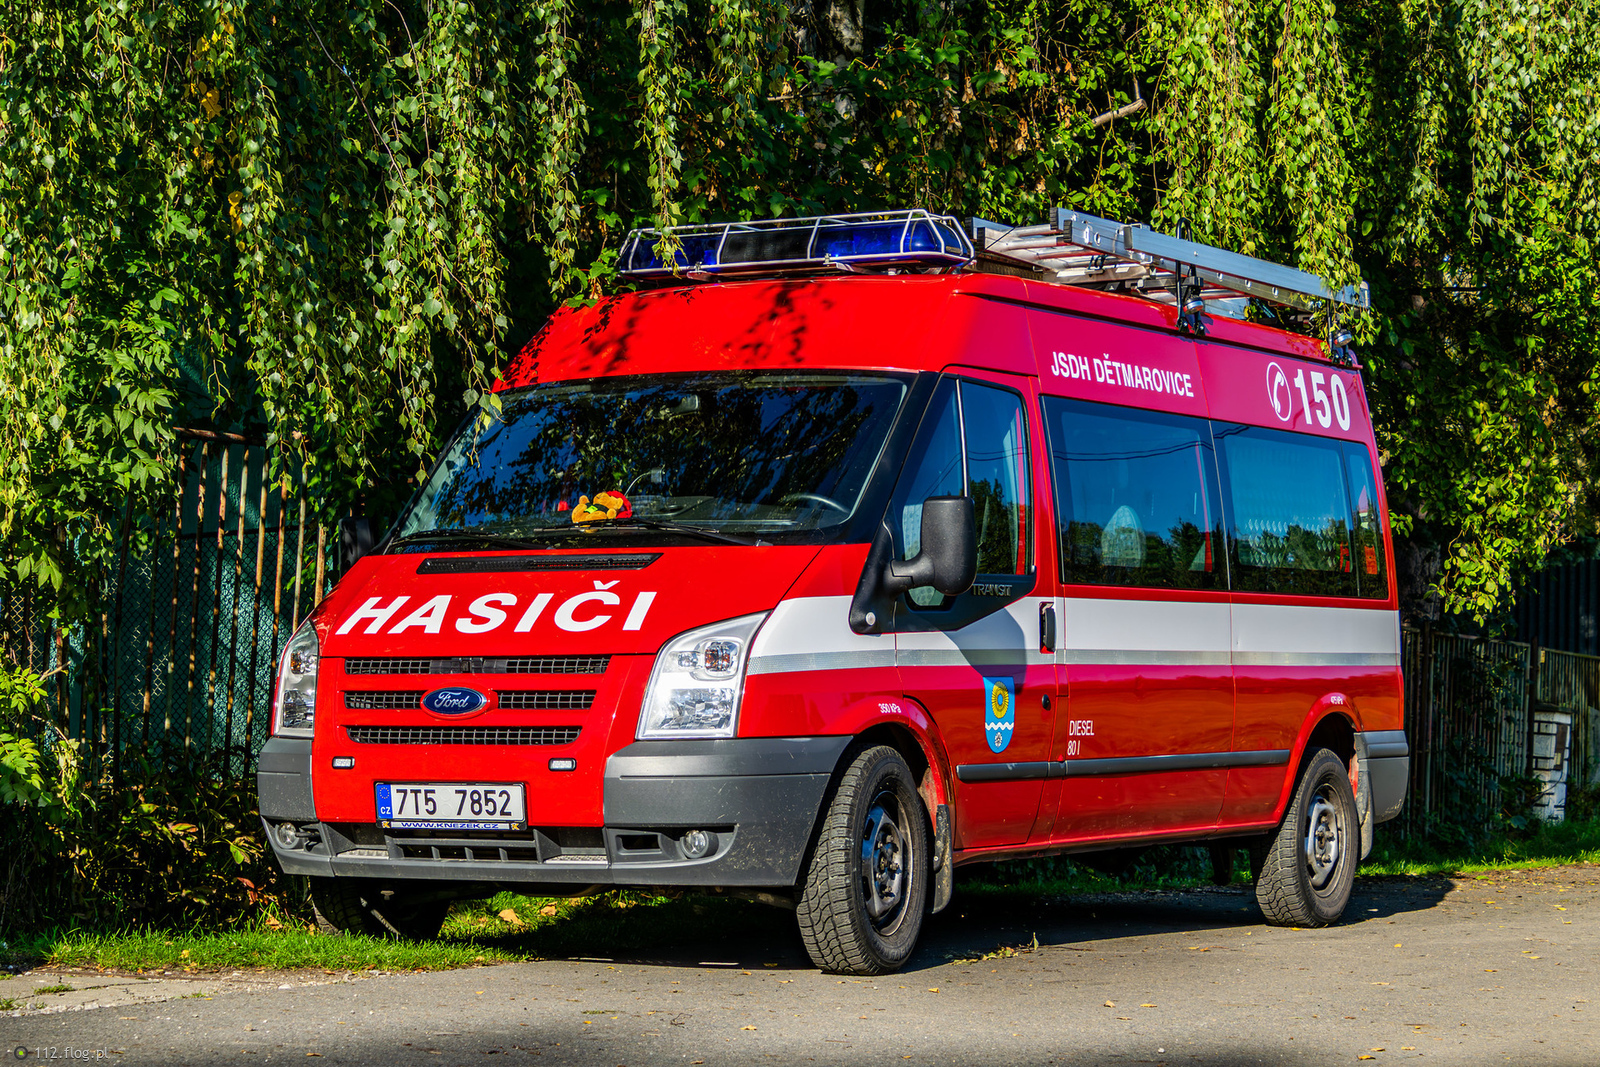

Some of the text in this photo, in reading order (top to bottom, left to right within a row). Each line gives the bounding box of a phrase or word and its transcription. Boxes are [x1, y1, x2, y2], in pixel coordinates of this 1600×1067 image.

[1051, 352, 1194, 397] JSDH DĚTMAROVICE
[1295, 368, 1350, 431] 150
[972, 583, 1013, 596] TRANSIT
[335, 580, 657, 635] HASIČI
[434, 691, 470, 708] Ford
[1069, 720, 1095, 736] DIESEL
[1067, 740, 1077, 756] 80
[380, 806, 391, 815] CZ
[395, 788, 512, 816] 7T5 7852
